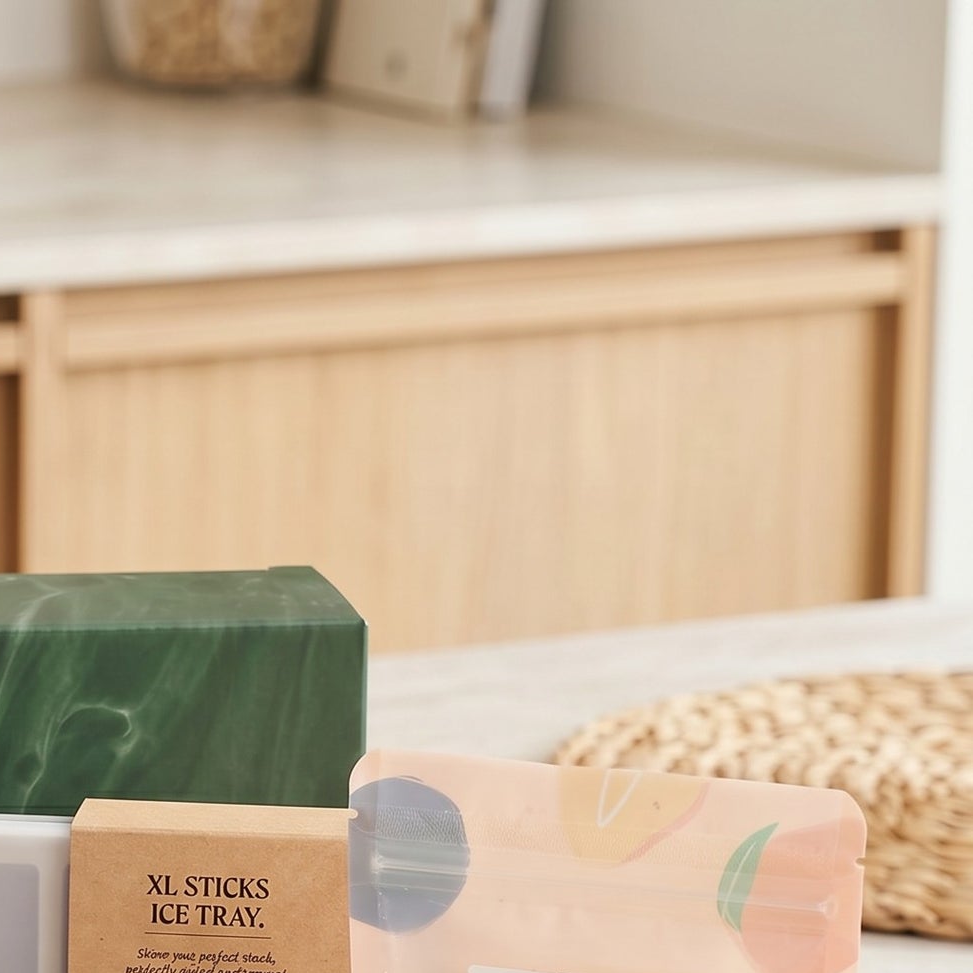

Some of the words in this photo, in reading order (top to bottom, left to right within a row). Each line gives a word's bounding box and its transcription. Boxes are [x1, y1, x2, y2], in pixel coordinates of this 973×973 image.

[146, 874, 178, 896] XL
[183, 875, 270, 899] STICKS
[151, 903, 189, 925] ICE
[195, 904, 265, 929] TRAY.
